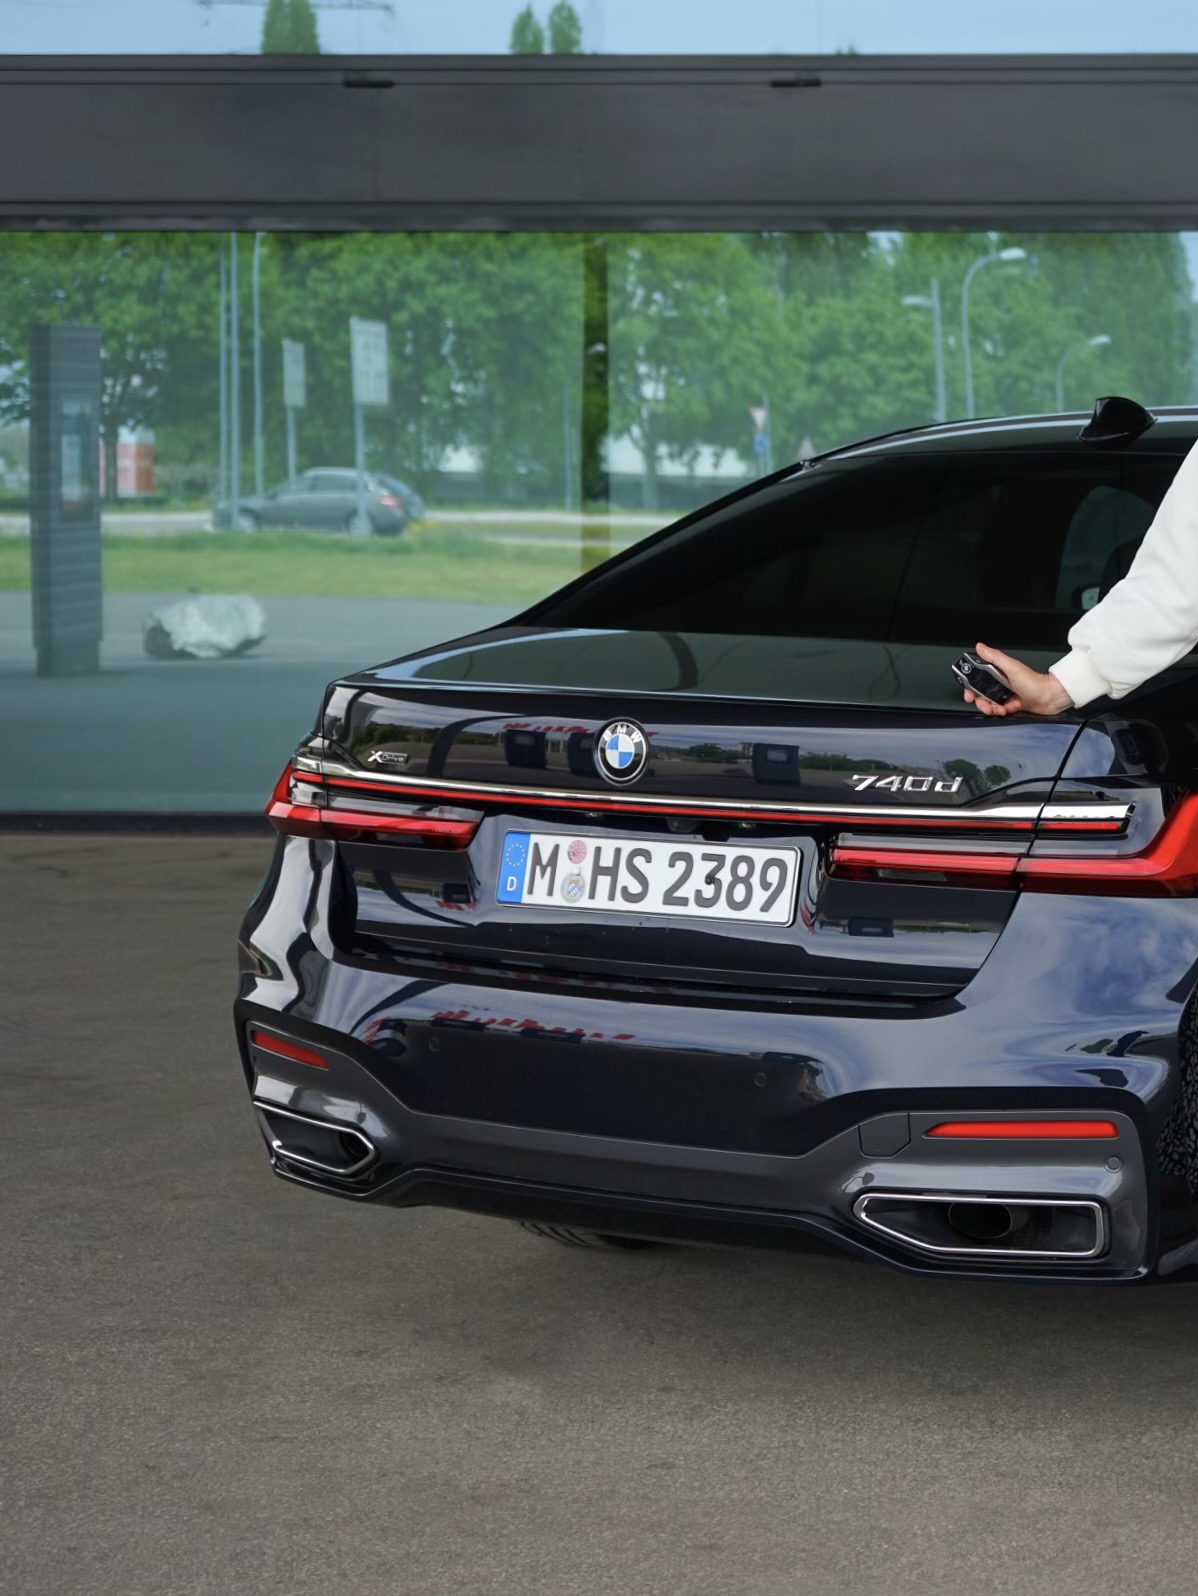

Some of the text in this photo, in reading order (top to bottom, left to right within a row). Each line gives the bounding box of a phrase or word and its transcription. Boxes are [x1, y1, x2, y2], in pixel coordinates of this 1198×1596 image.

[603, 724, 642, 743] BMW
[851, 774, 964, 793] 740d
[506, 876, 517, 891] D
[527, 842, 788, 912] M HS 2389
